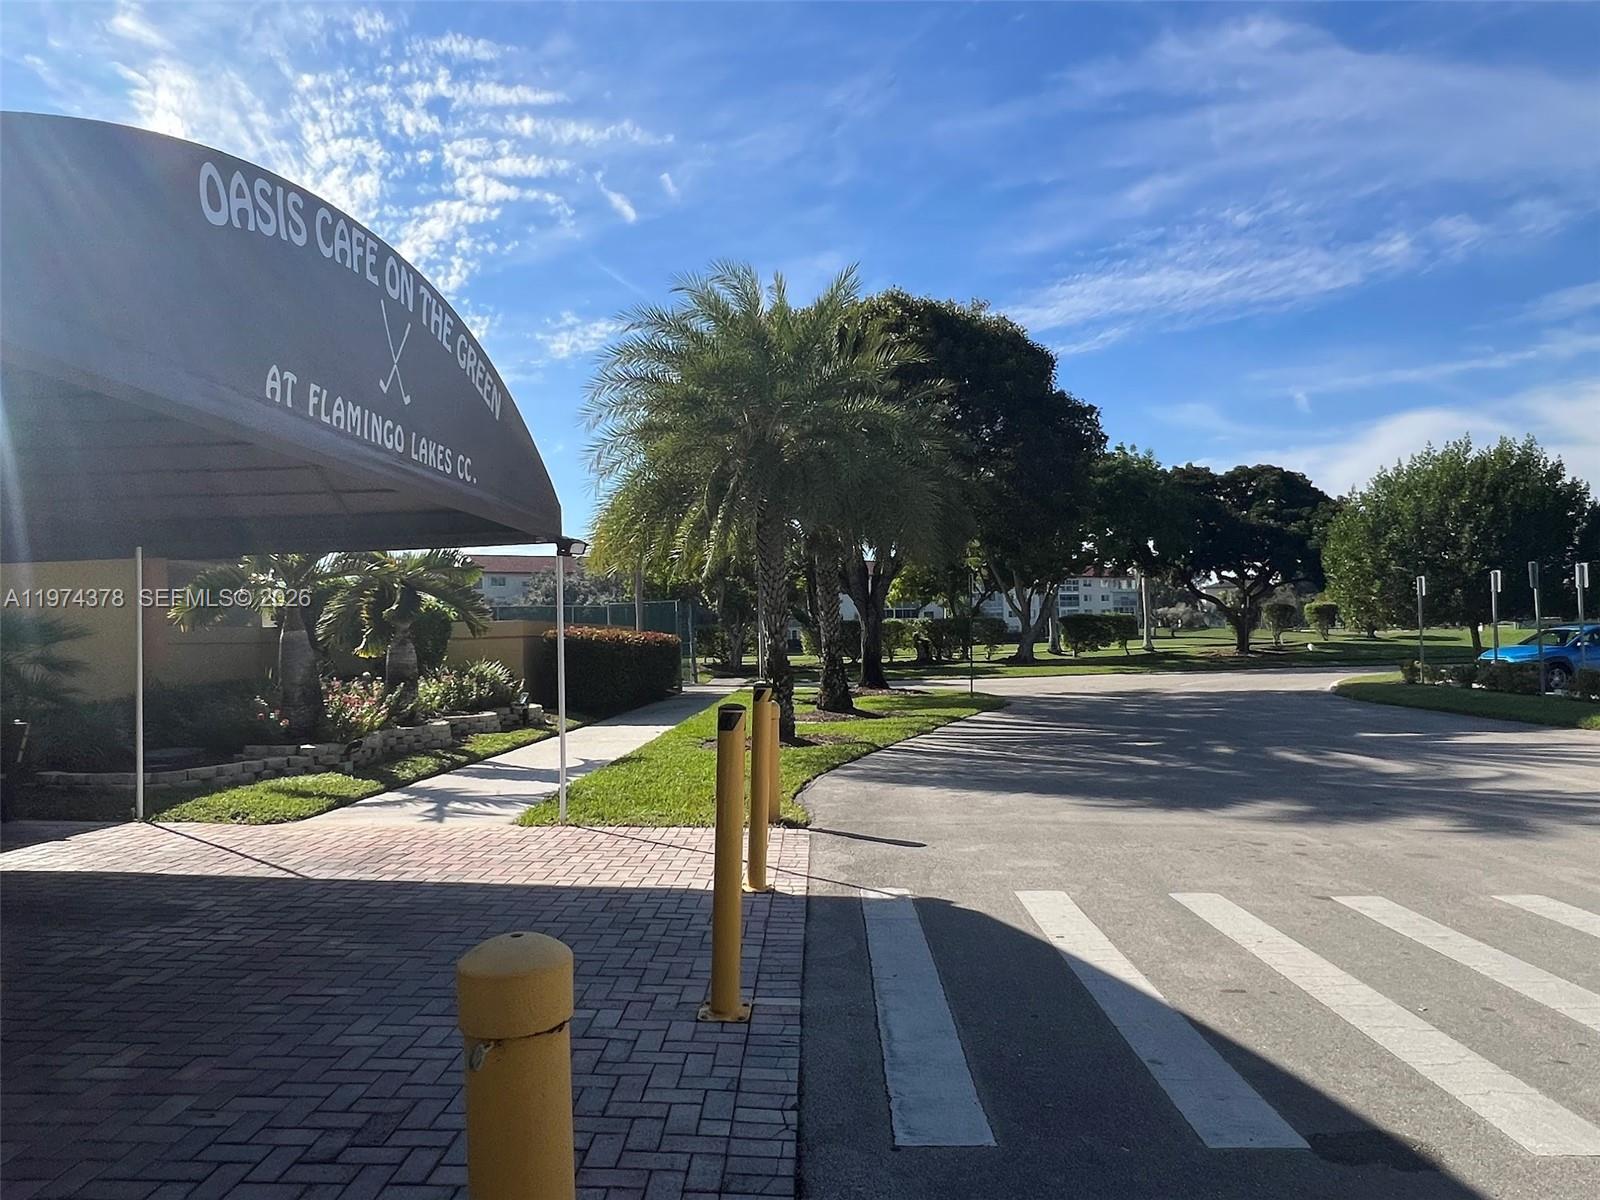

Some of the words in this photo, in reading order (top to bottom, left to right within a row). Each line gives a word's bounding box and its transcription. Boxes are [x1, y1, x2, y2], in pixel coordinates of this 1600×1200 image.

[200, 162, 307, 247] OASIS
[315, 207, 379, 286] CAFE
[385, 255, 414, 312] ON
[419, 286, 453, 353] THE
[457, 334, 501, 421] GREEN
[265, 364, 297, 408] AT
[308, 383, 405, 453] FLAMINGO
[411, 432, 452, 473] LAKES
